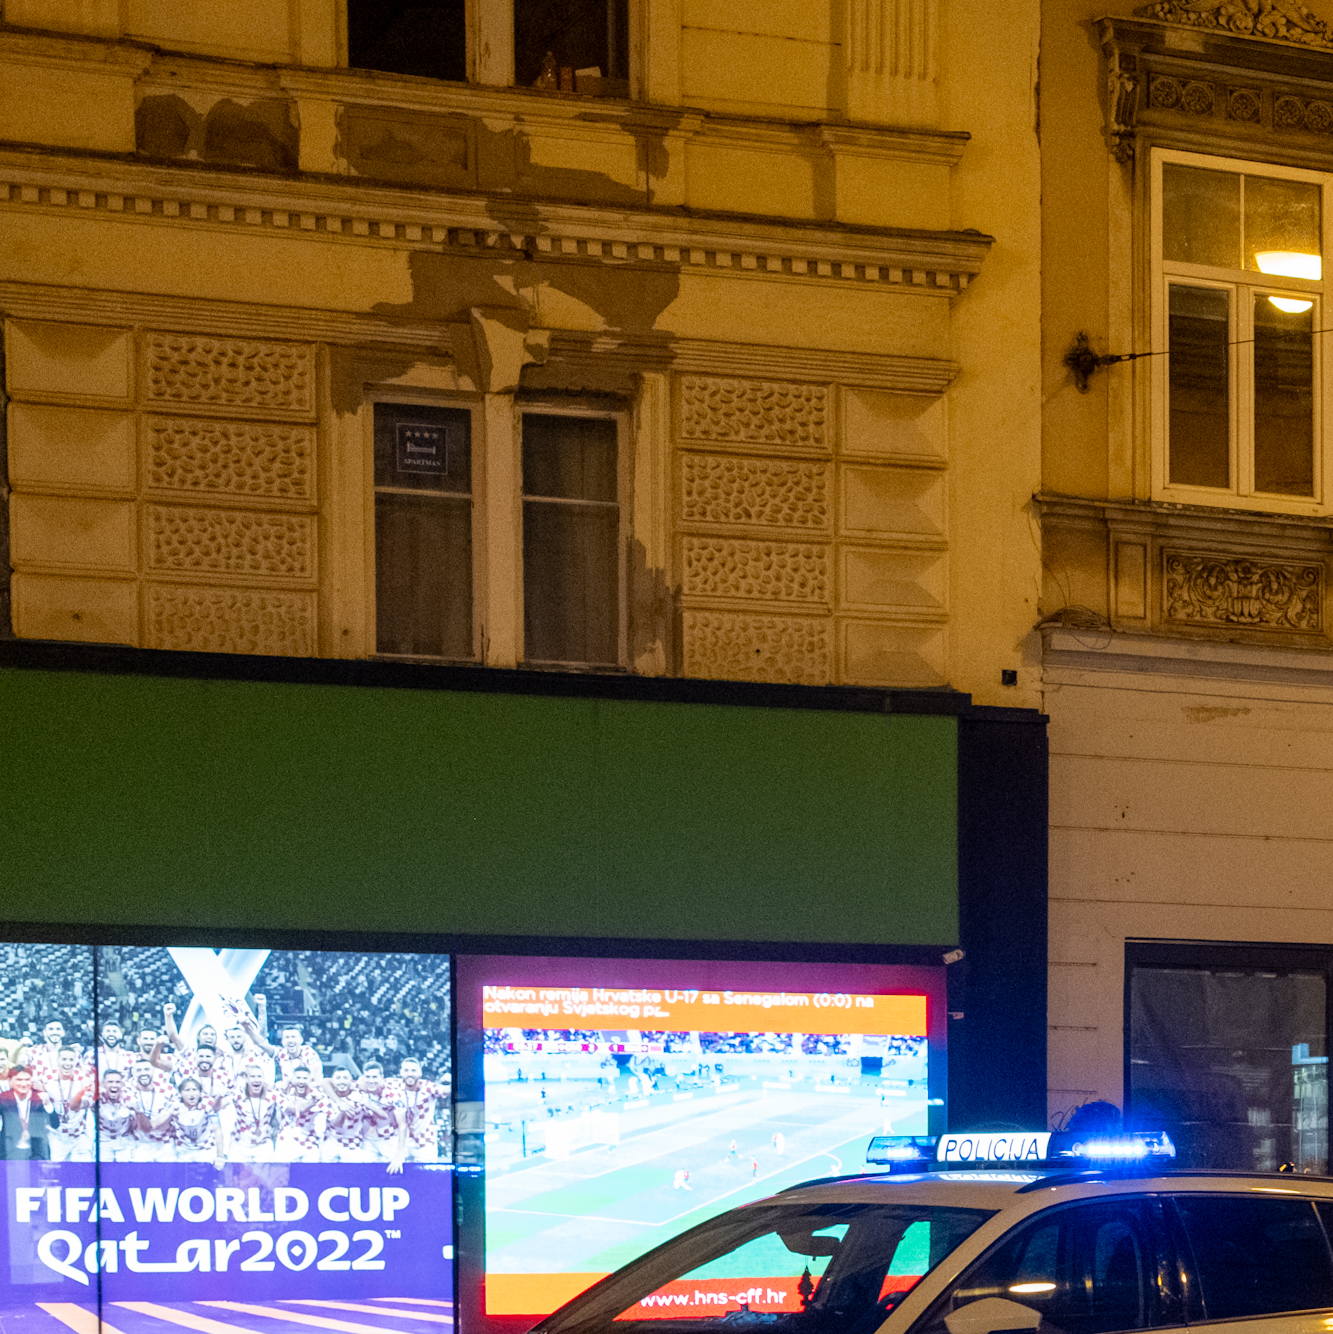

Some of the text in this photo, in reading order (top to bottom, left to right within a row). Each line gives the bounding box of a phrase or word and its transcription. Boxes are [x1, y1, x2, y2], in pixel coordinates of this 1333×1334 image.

[483, 986, 874, 1009] Nakon remija Hrvatske U-17 sa Senegalom (0:0) na
[483, 1001, 559, 1016] otvaranju
[563, 1001, 640, 1018] Svjetskog
[945, 1138, 1040, 1161] POLICIJA
[15, 1186, 410, 1223] FIFA WORLD CUP
[640, 1288, 787, 1307] www.hns-cff.hr
